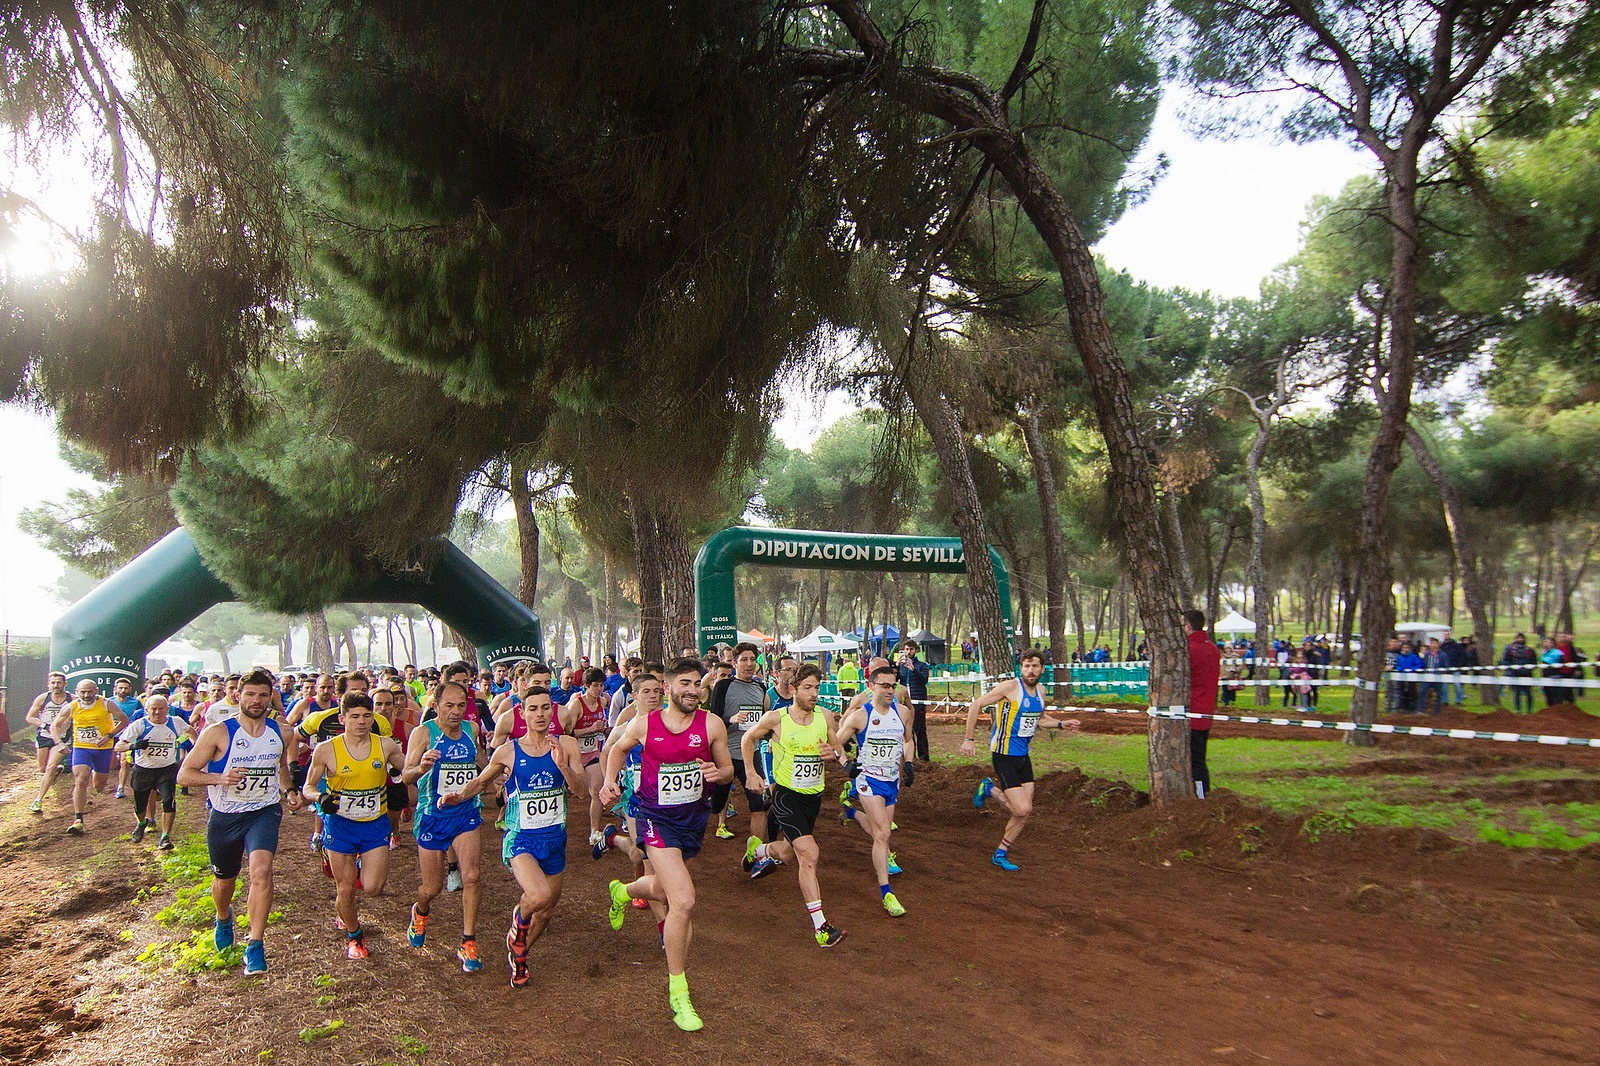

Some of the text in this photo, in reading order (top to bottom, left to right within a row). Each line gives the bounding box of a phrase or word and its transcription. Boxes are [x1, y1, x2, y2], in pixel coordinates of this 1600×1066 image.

[752, 539, 869, 561] DIPUTACION
[874, 546, 896, 562] DE
[486, 645, 541, 662] DIPUTACION
[62, 655, 141, 673] DIPUTACION
[97, 677, 111, 685] DE
[81, 730, 98, 739] 228
[584, 737, 595, 747] 60
[148, 747, 169, 757] 225
[871, 745, 894, 758] 367
[794, 762, 824, 778] 2950
[236, 776, 270, 791] 374
[445, 771, 474, 786] 569
[661, 771, 701, 792] 2952
[347, 796, 376, 809] 745
[527, 797, 559, 816] 604
